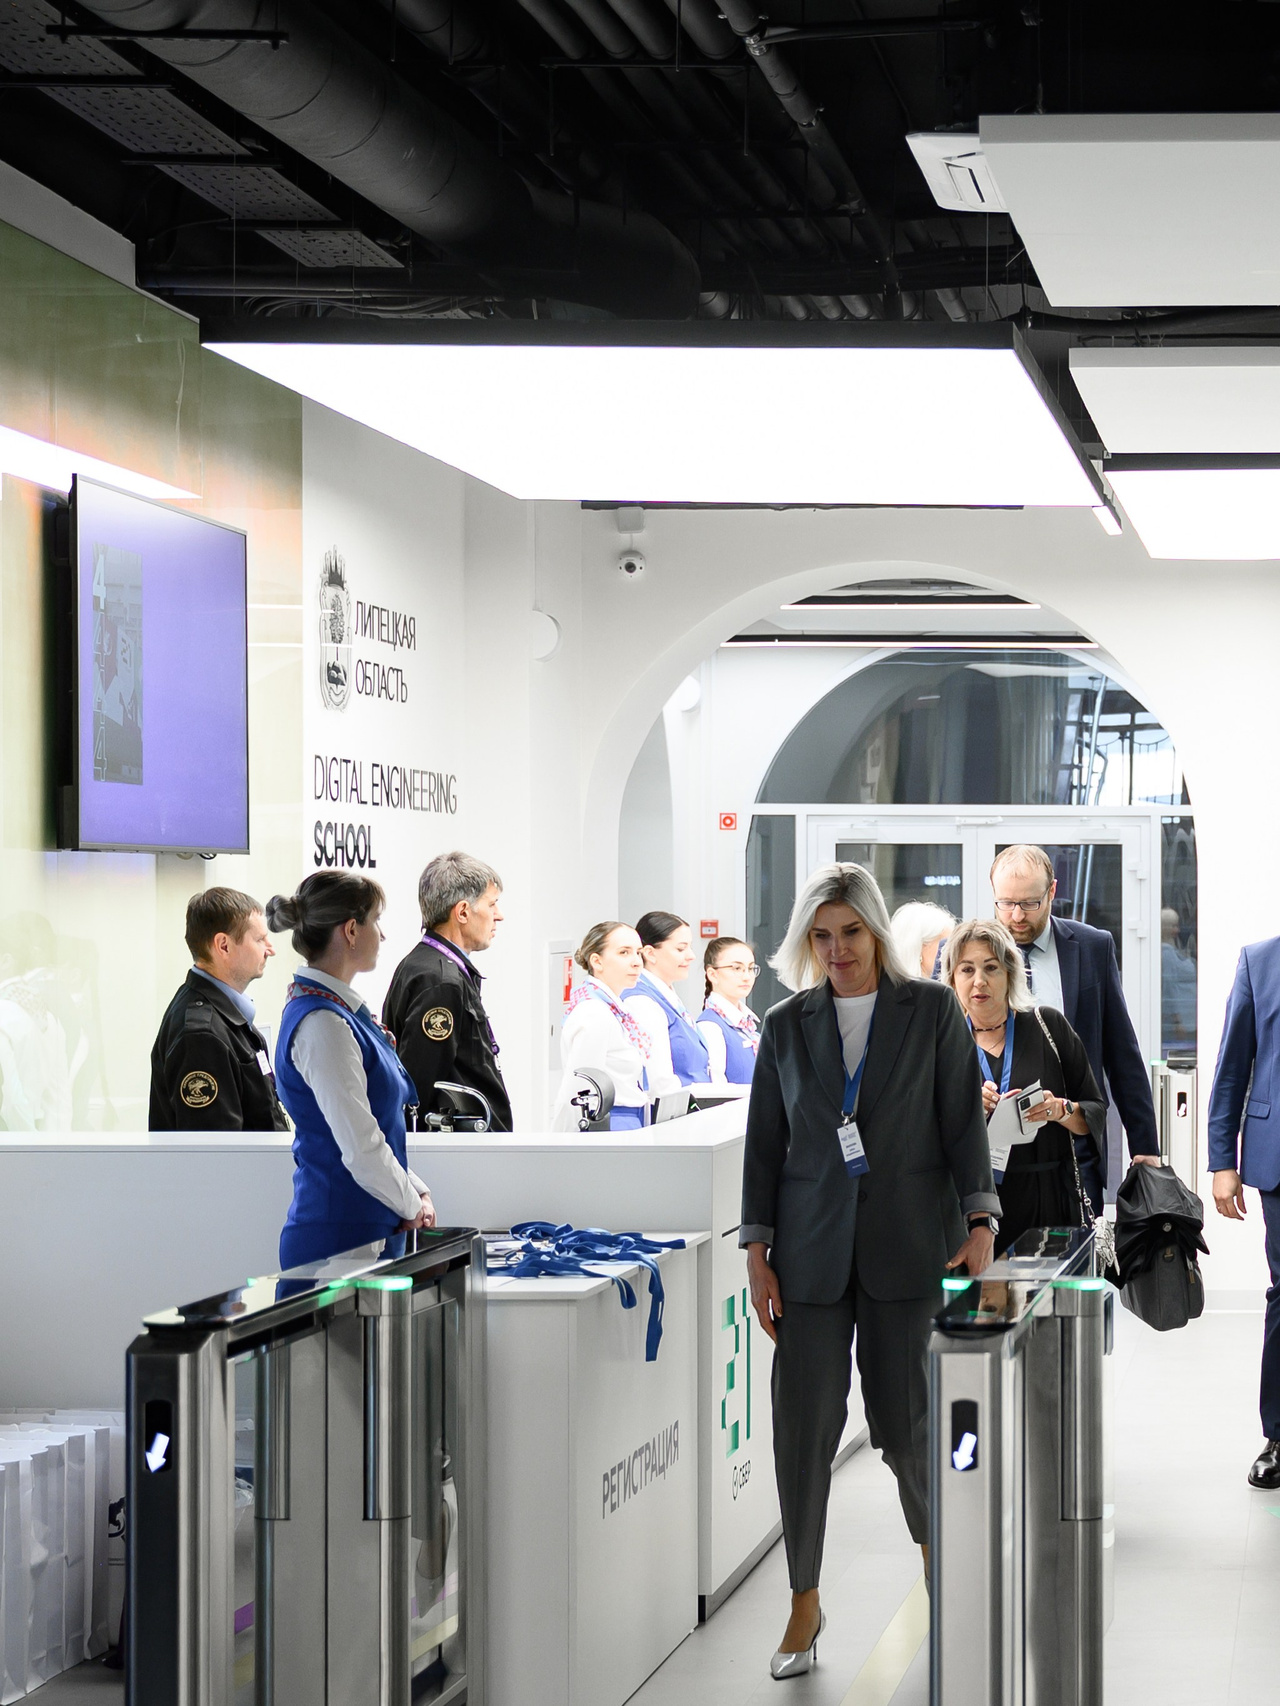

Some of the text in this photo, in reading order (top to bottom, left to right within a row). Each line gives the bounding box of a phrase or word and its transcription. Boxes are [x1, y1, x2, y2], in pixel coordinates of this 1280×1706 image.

[354, 600, 417, 652] ЛИПЕЦКАЯ
[355, 659, 408, 703] ОБЛАСТЬ
[314, 755, 458, 815] DIGITAL ENGINEERING
[313, 819, 377, 869] SCHOOL
[602, 1419, 679, 1519] РЕГИСТРАЦИЯ
